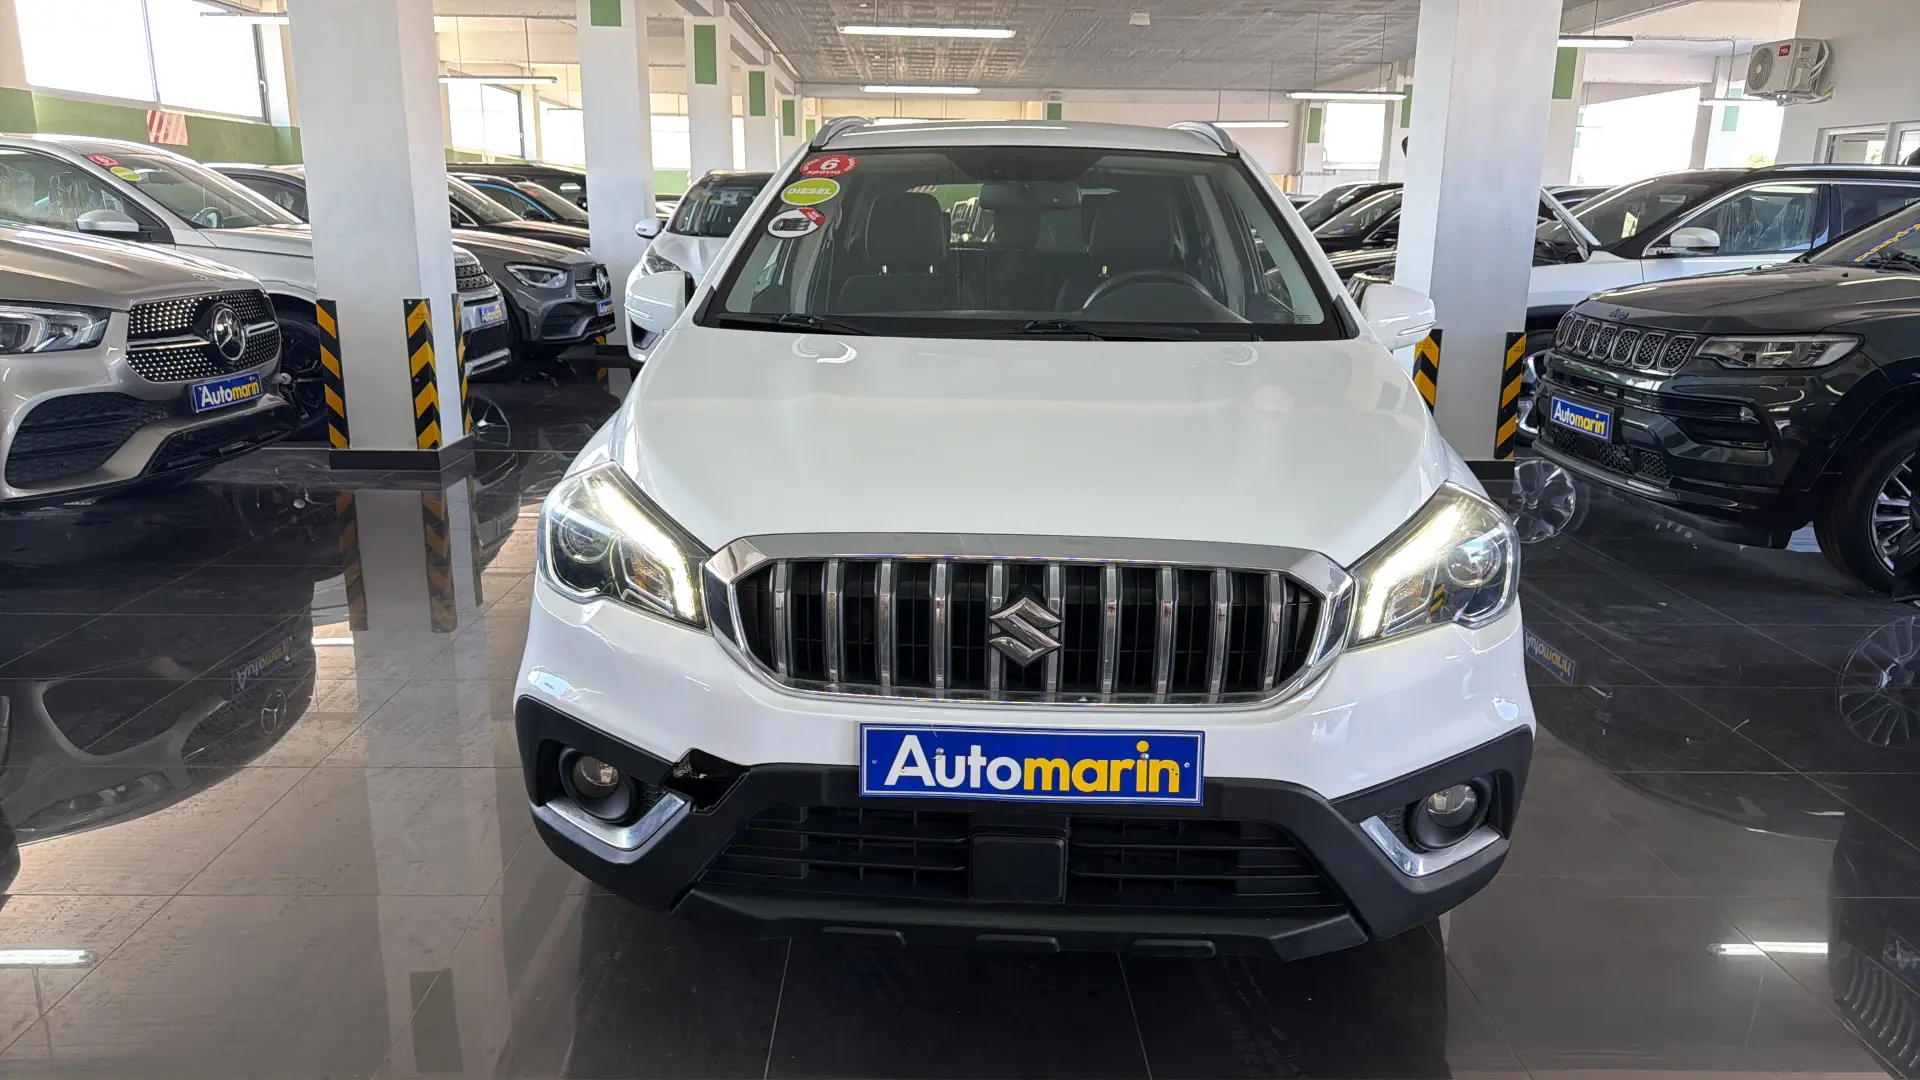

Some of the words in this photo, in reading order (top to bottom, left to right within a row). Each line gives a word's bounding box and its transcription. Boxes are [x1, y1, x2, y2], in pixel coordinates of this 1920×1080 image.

[820, 158, 841, 170] 6
[786, 187, 832, 195] DIESEL
[201, 376, 260, 407] Automarin
[1553, 401, 1605, 435] Automarin
[884, 734, 1180, 793] Automarin
